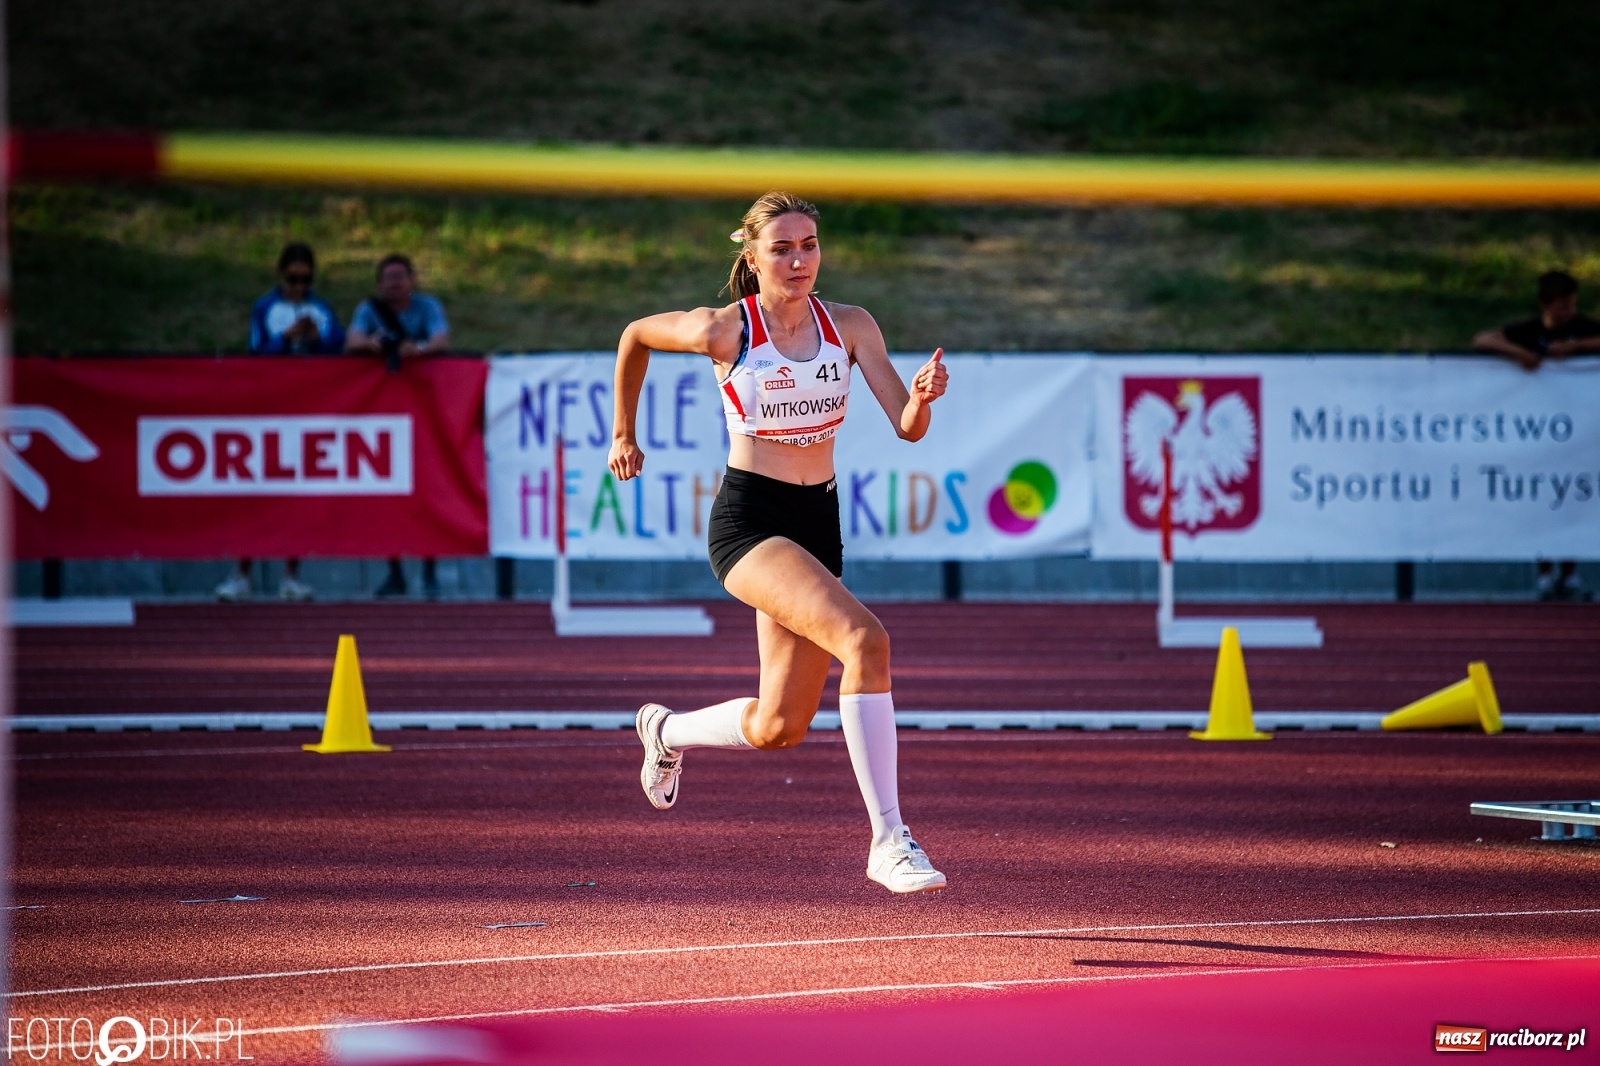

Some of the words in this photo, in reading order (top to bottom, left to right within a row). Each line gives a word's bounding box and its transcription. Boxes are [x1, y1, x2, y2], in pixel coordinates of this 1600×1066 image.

[765, 381, 794, 390] ORLEN
[815, 362, 841, 383] 41
[518, 371, 699, 450] NESLÉ
[761, 394, 846, 419] WITKOWSKA
[818, 428, 835, 441] 2019
[1290, 403, 1575, 443] Ministerstwo
[153, 429, 393, 483] ORLEN
[850, 469, 970, 536] KIDS
[1289, 463, 1432, 511] Sportu
[1450, 463, 1461, 501] i
[1477, 463, 1600, 511] Turys
[657, 759, 679, 770] NIKE
